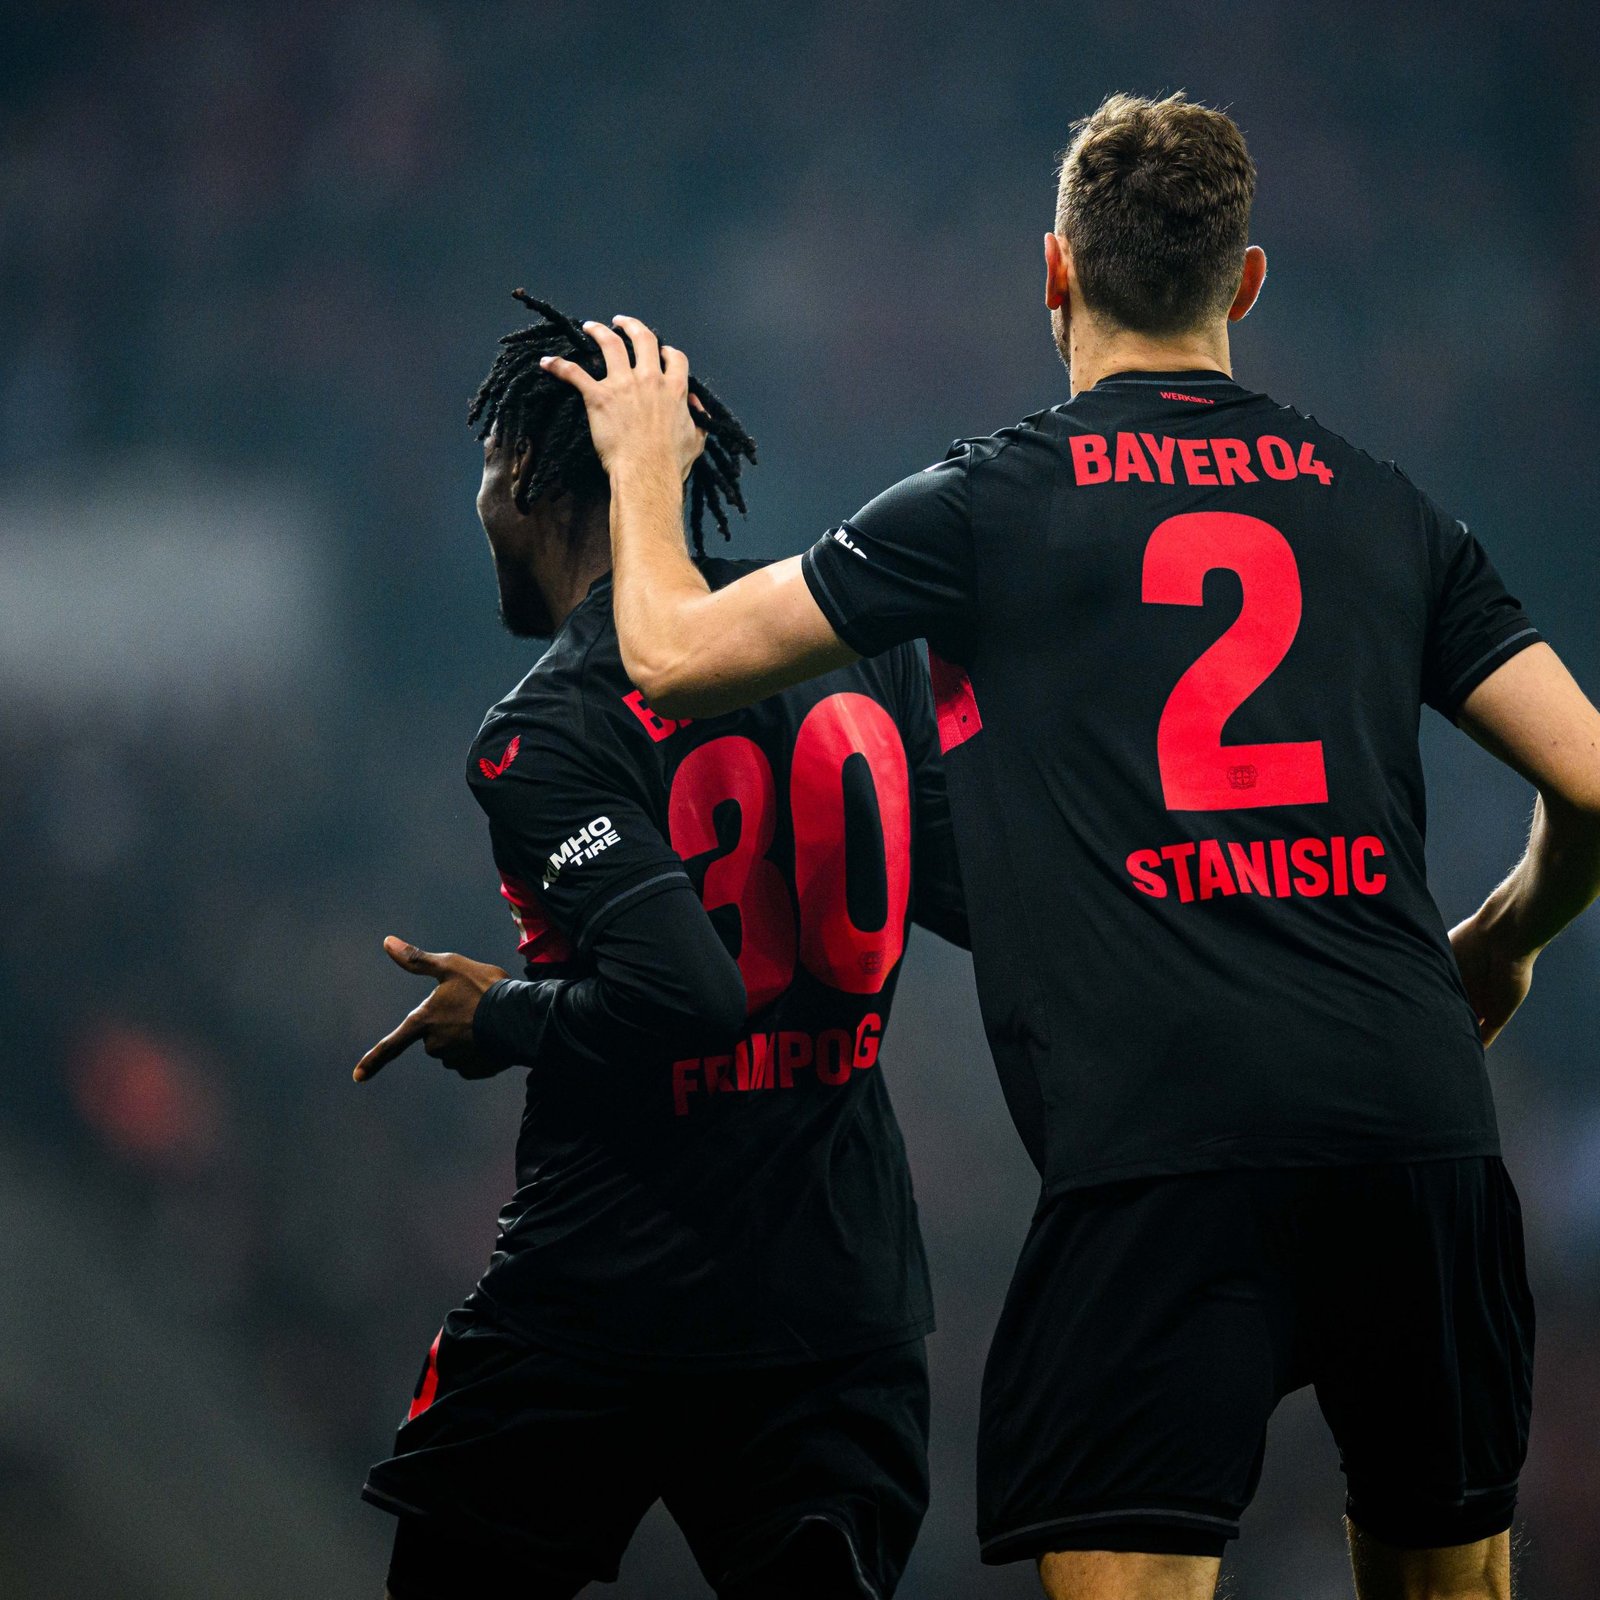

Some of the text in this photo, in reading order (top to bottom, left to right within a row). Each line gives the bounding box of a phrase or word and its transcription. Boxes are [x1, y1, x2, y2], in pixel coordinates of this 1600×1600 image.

[1069, 432, 1334, 486] BAYER 04
[1141, 511, 1329, 811] 2
[570, 829, 621, 867] TIRE
[668, 692, 911, 1016] 30
[1125, 836, 1387, 903] STANISIC
[672, 1012, 882, 1116] FRIMPOG
